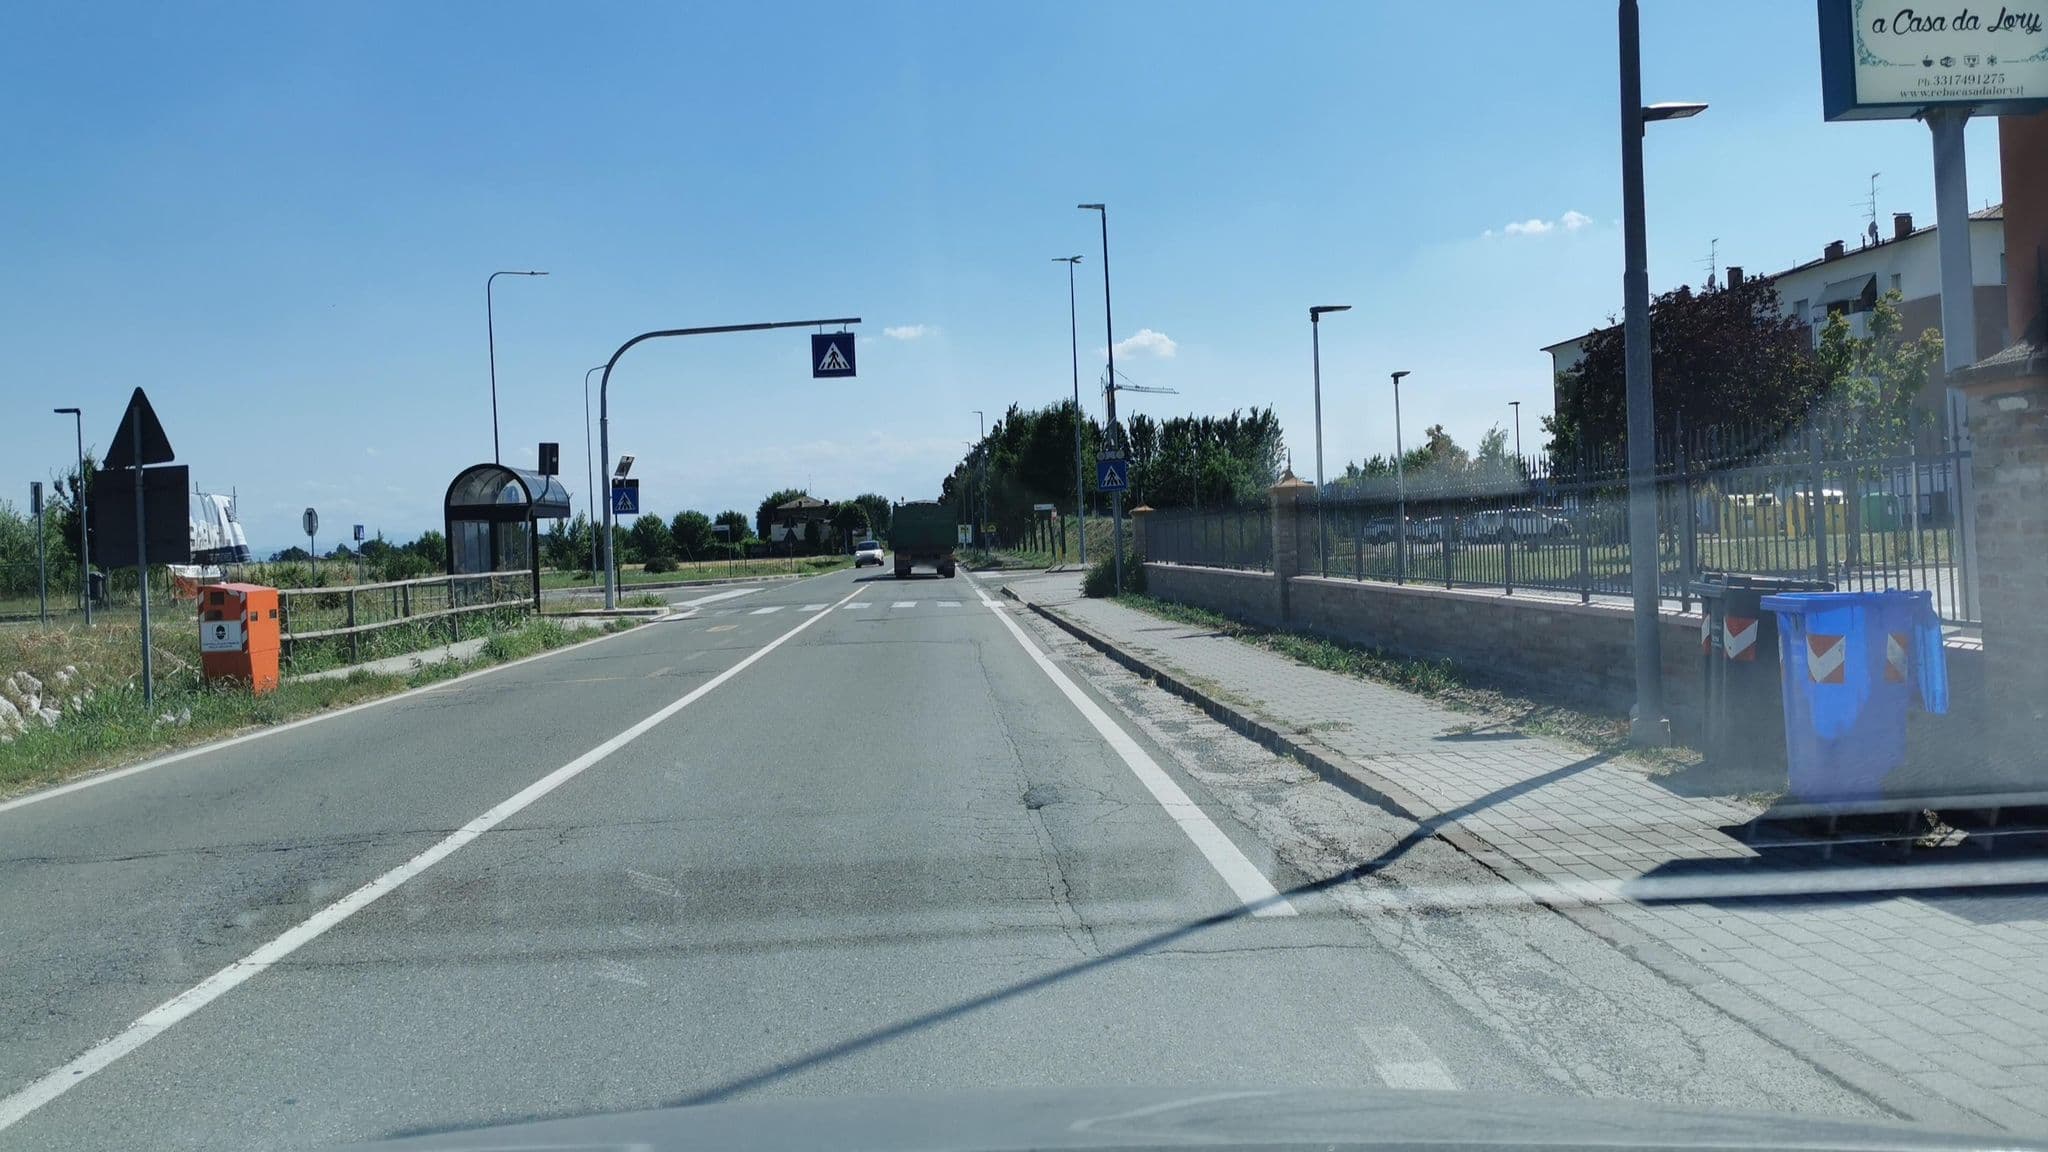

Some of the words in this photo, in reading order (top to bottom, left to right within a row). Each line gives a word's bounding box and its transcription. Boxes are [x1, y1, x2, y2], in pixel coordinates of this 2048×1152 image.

[1872, 18, 1887, 33] a
[1893, 9, 1947, 35] Casa
[1952, 8, 1981, 31] da
[1987, 6, 2042, 35] Lory
